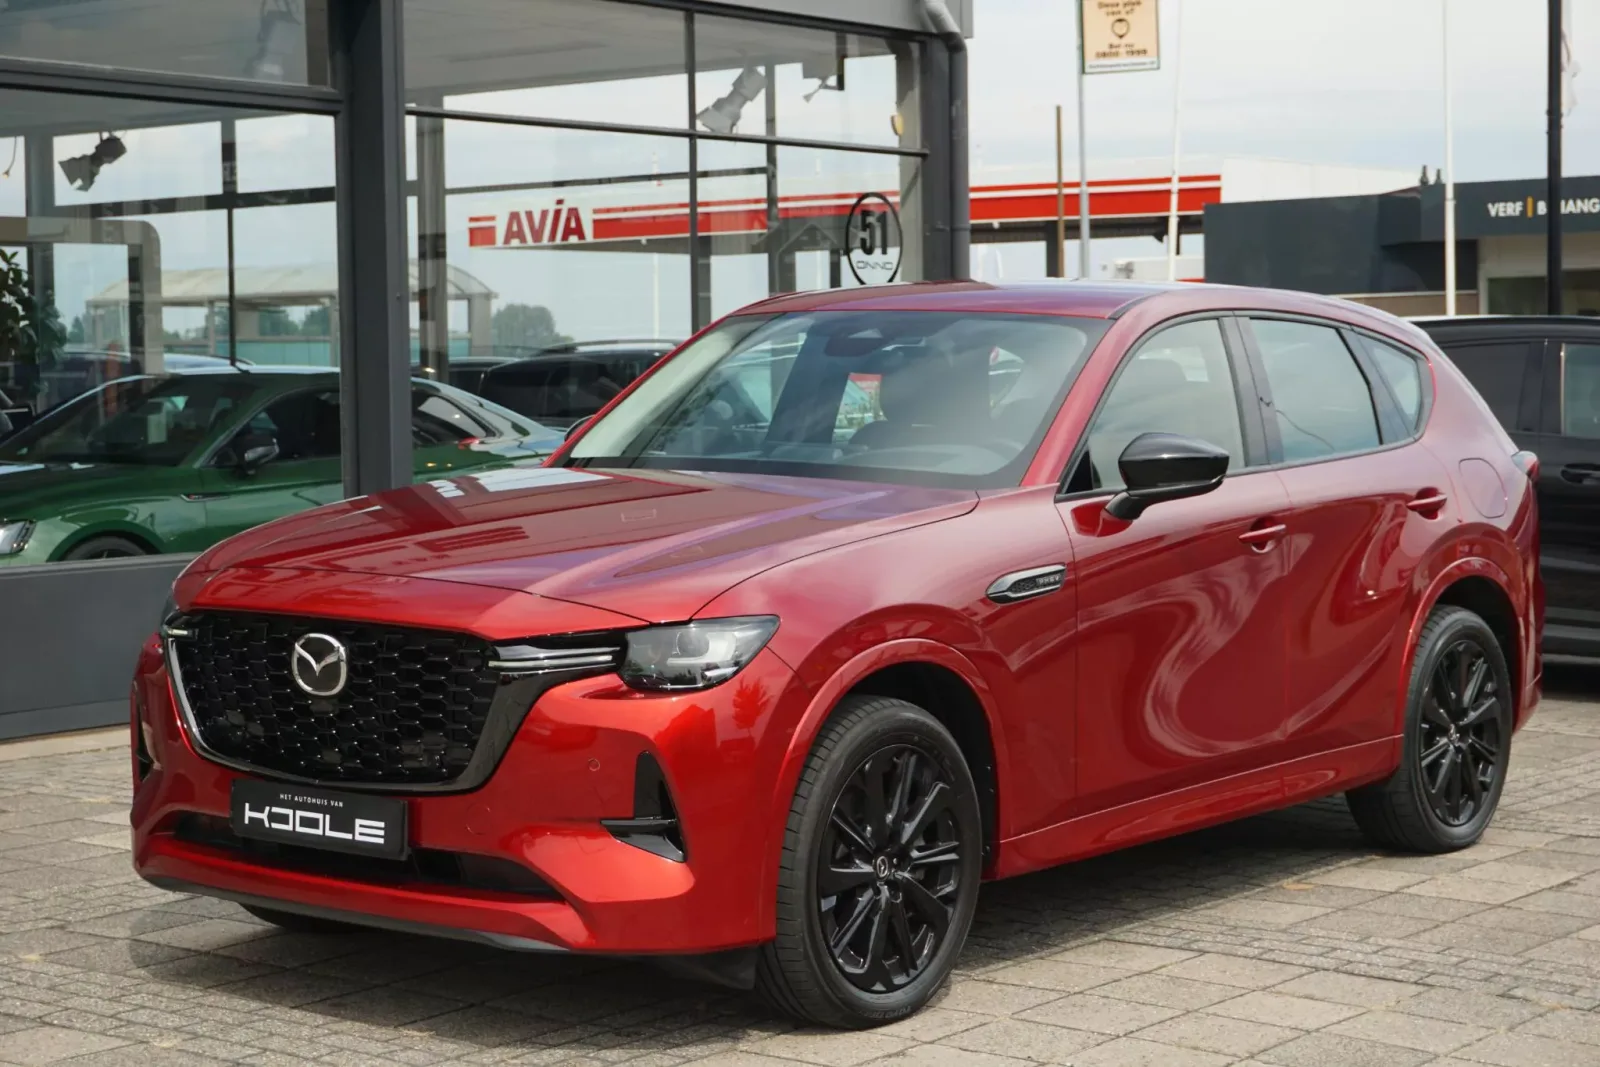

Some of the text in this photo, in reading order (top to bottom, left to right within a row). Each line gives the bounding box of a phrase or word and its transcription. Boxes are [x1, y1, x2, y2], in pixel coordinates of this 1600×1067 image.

[1487, 201, 1524, 217] VERF
[860, 209, 887, 255] 51
[279, 793, 344, 808] HET AUTOHUIS VAN
[244, 802, 386, 844] KOOLE
